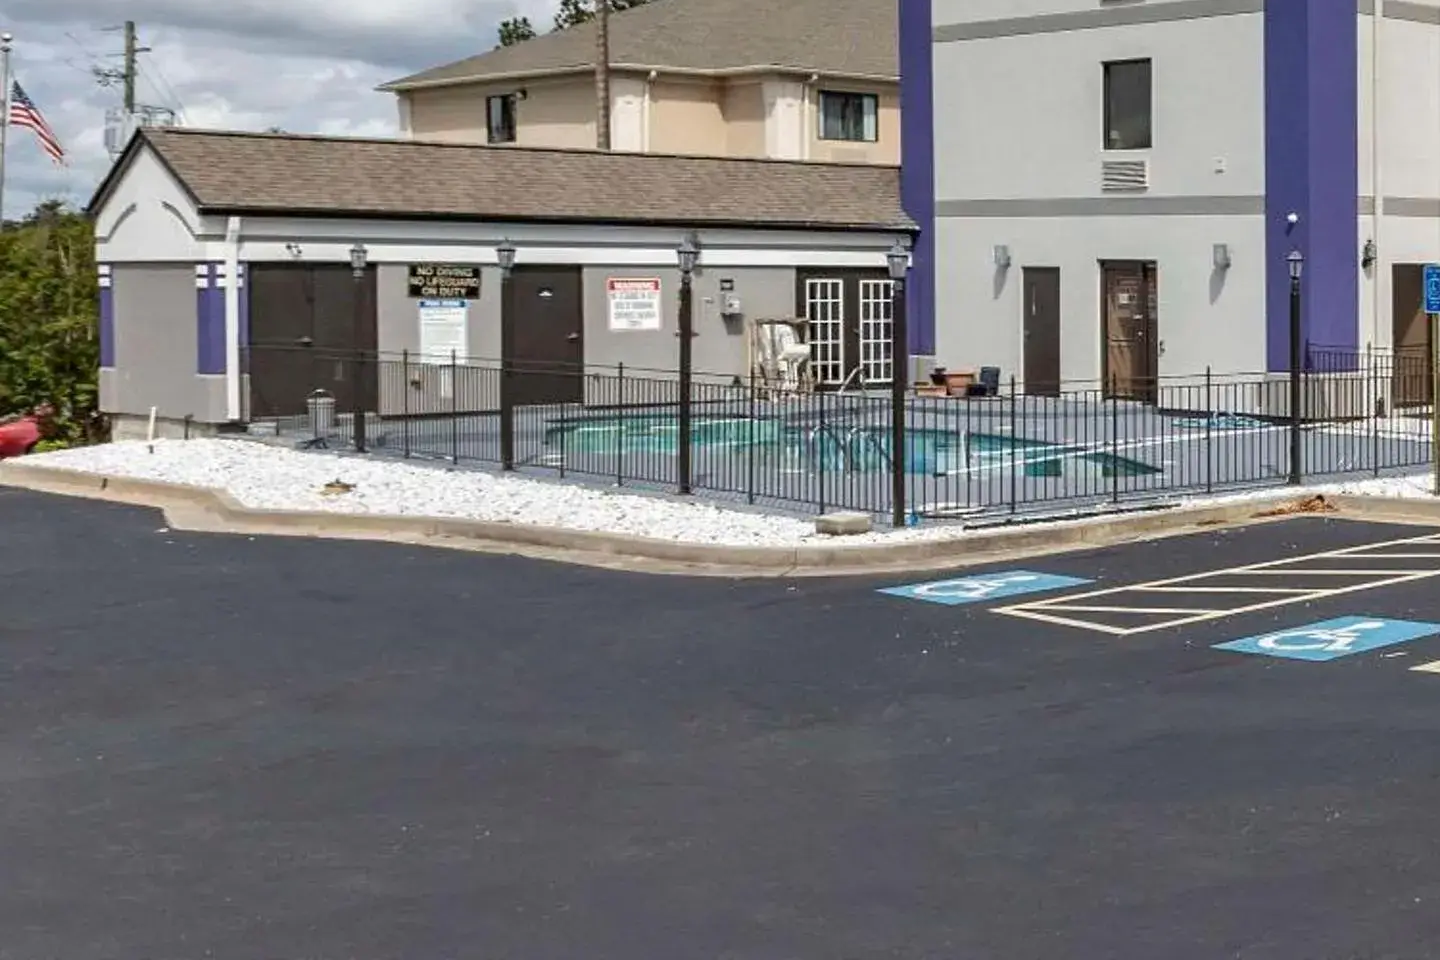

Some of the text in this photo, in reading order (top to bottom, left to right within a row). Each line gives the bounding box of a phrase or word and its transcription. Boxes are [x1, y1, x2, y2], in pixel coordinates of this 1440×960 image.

[416, 267, 473, 276] NO DIVING
[410, 277, 479, 287] NO LIFEGUARD
[422, 287, 466, 296] ON DUTY
